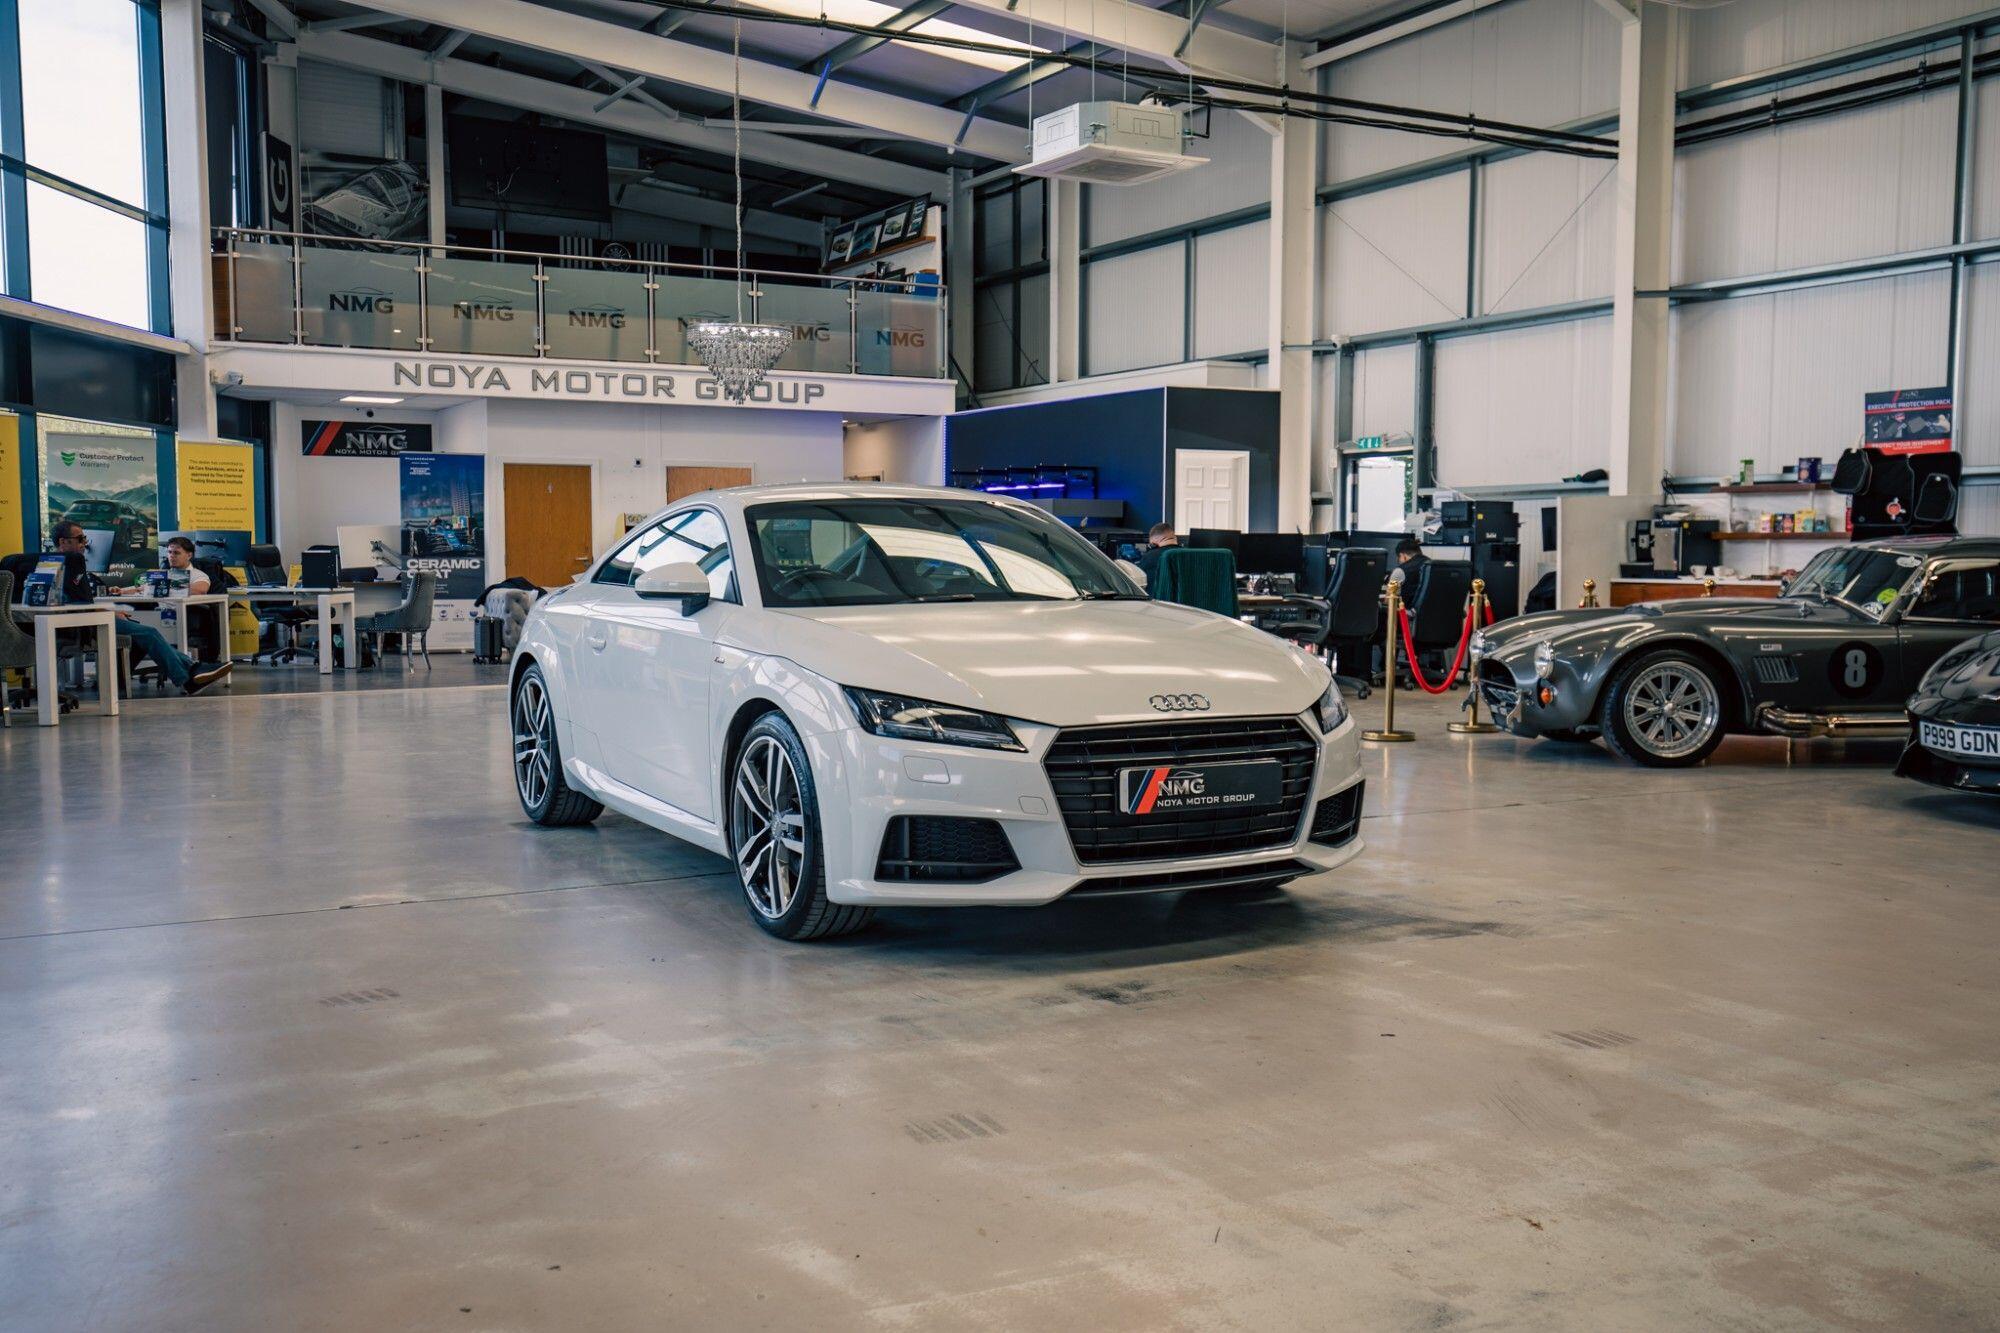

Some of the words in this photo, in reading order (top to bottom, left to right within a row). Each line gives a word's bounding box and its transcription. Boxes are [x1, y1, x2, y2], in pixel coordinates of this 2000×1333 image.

[329, 293, 394, 314] NMG
[453, 303, 514, 322] NMG
[568, 310, 626, 329] NMG
[876, 330, 925, 347] NMG
[394, 362, 511, 391] NOYA
[531, 368, 676, 398] MOTOR
[695, 377, 825, 404] GOUP
[1867, 402, 1898, 410] EXECUTIVE
[345, 432, 407, 450] NMG
[79, 452, 116, 461] Customer
[116, 454, 144, 462] Protect
[80, 461, 110, 469] Warranty
[406, 558, 481, 570] CERAMIC
[406, 568, 452, 579] CAT
[1844, 649, 1867, 688] 8
[1924, 724, 1956, 749] P999
[1960, 731, 1999, 754] GDN
[1158, 778, 1205, 797] NMG
[1157, 799, 1183, 808] NOYA
[1186, 796, 1220, 805] MOTOR
[1222, 794, 1256, 802] GROUP
